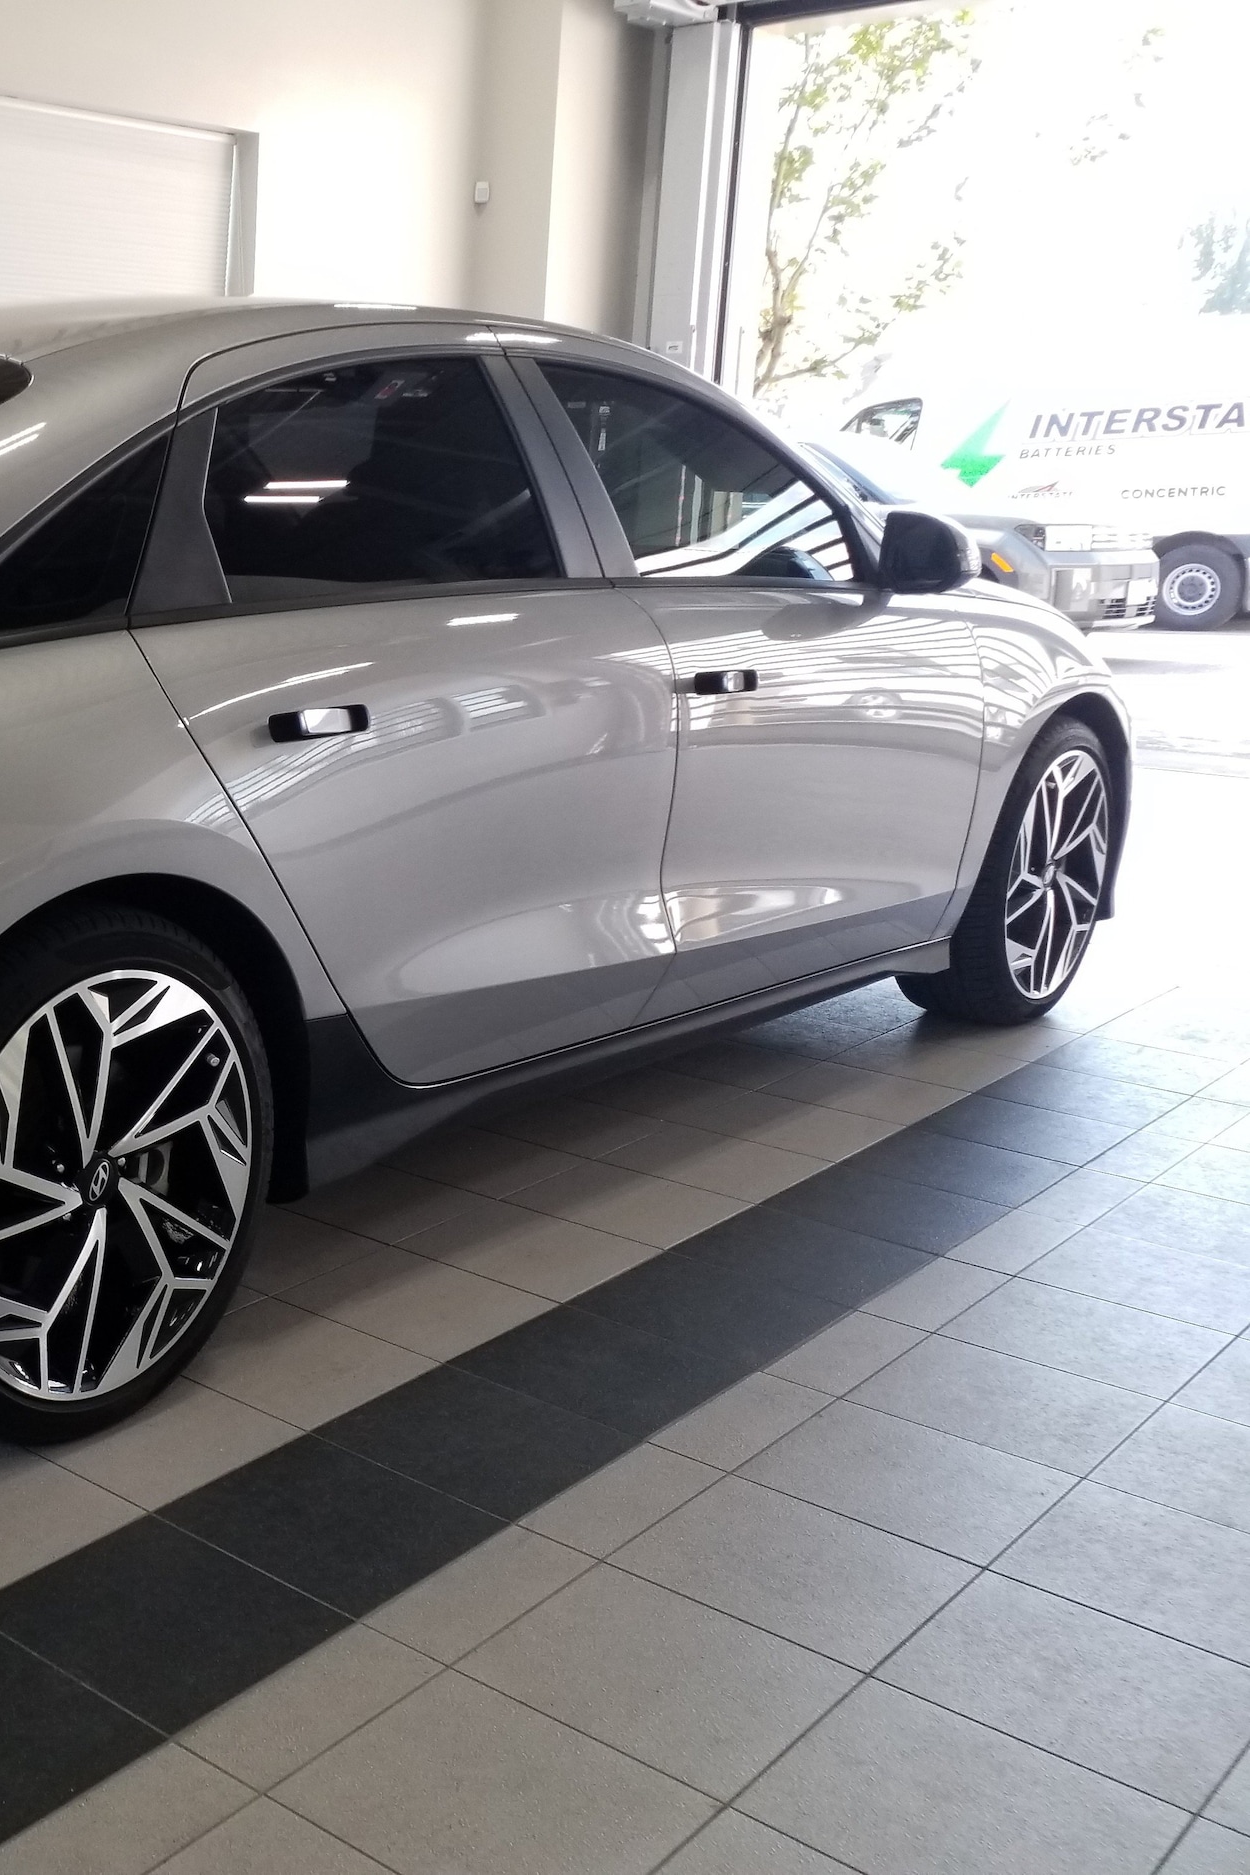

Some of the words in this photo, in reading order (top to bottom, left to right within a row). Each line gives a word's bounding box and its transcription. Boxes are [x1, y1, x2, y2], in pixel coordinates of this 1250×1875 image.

[1029, 402, 1245, 437] INTERSTA
[1019, 444, 1116, 459] BATTERIES
[1120, 486, 1227, 499] CONCENTRIC
